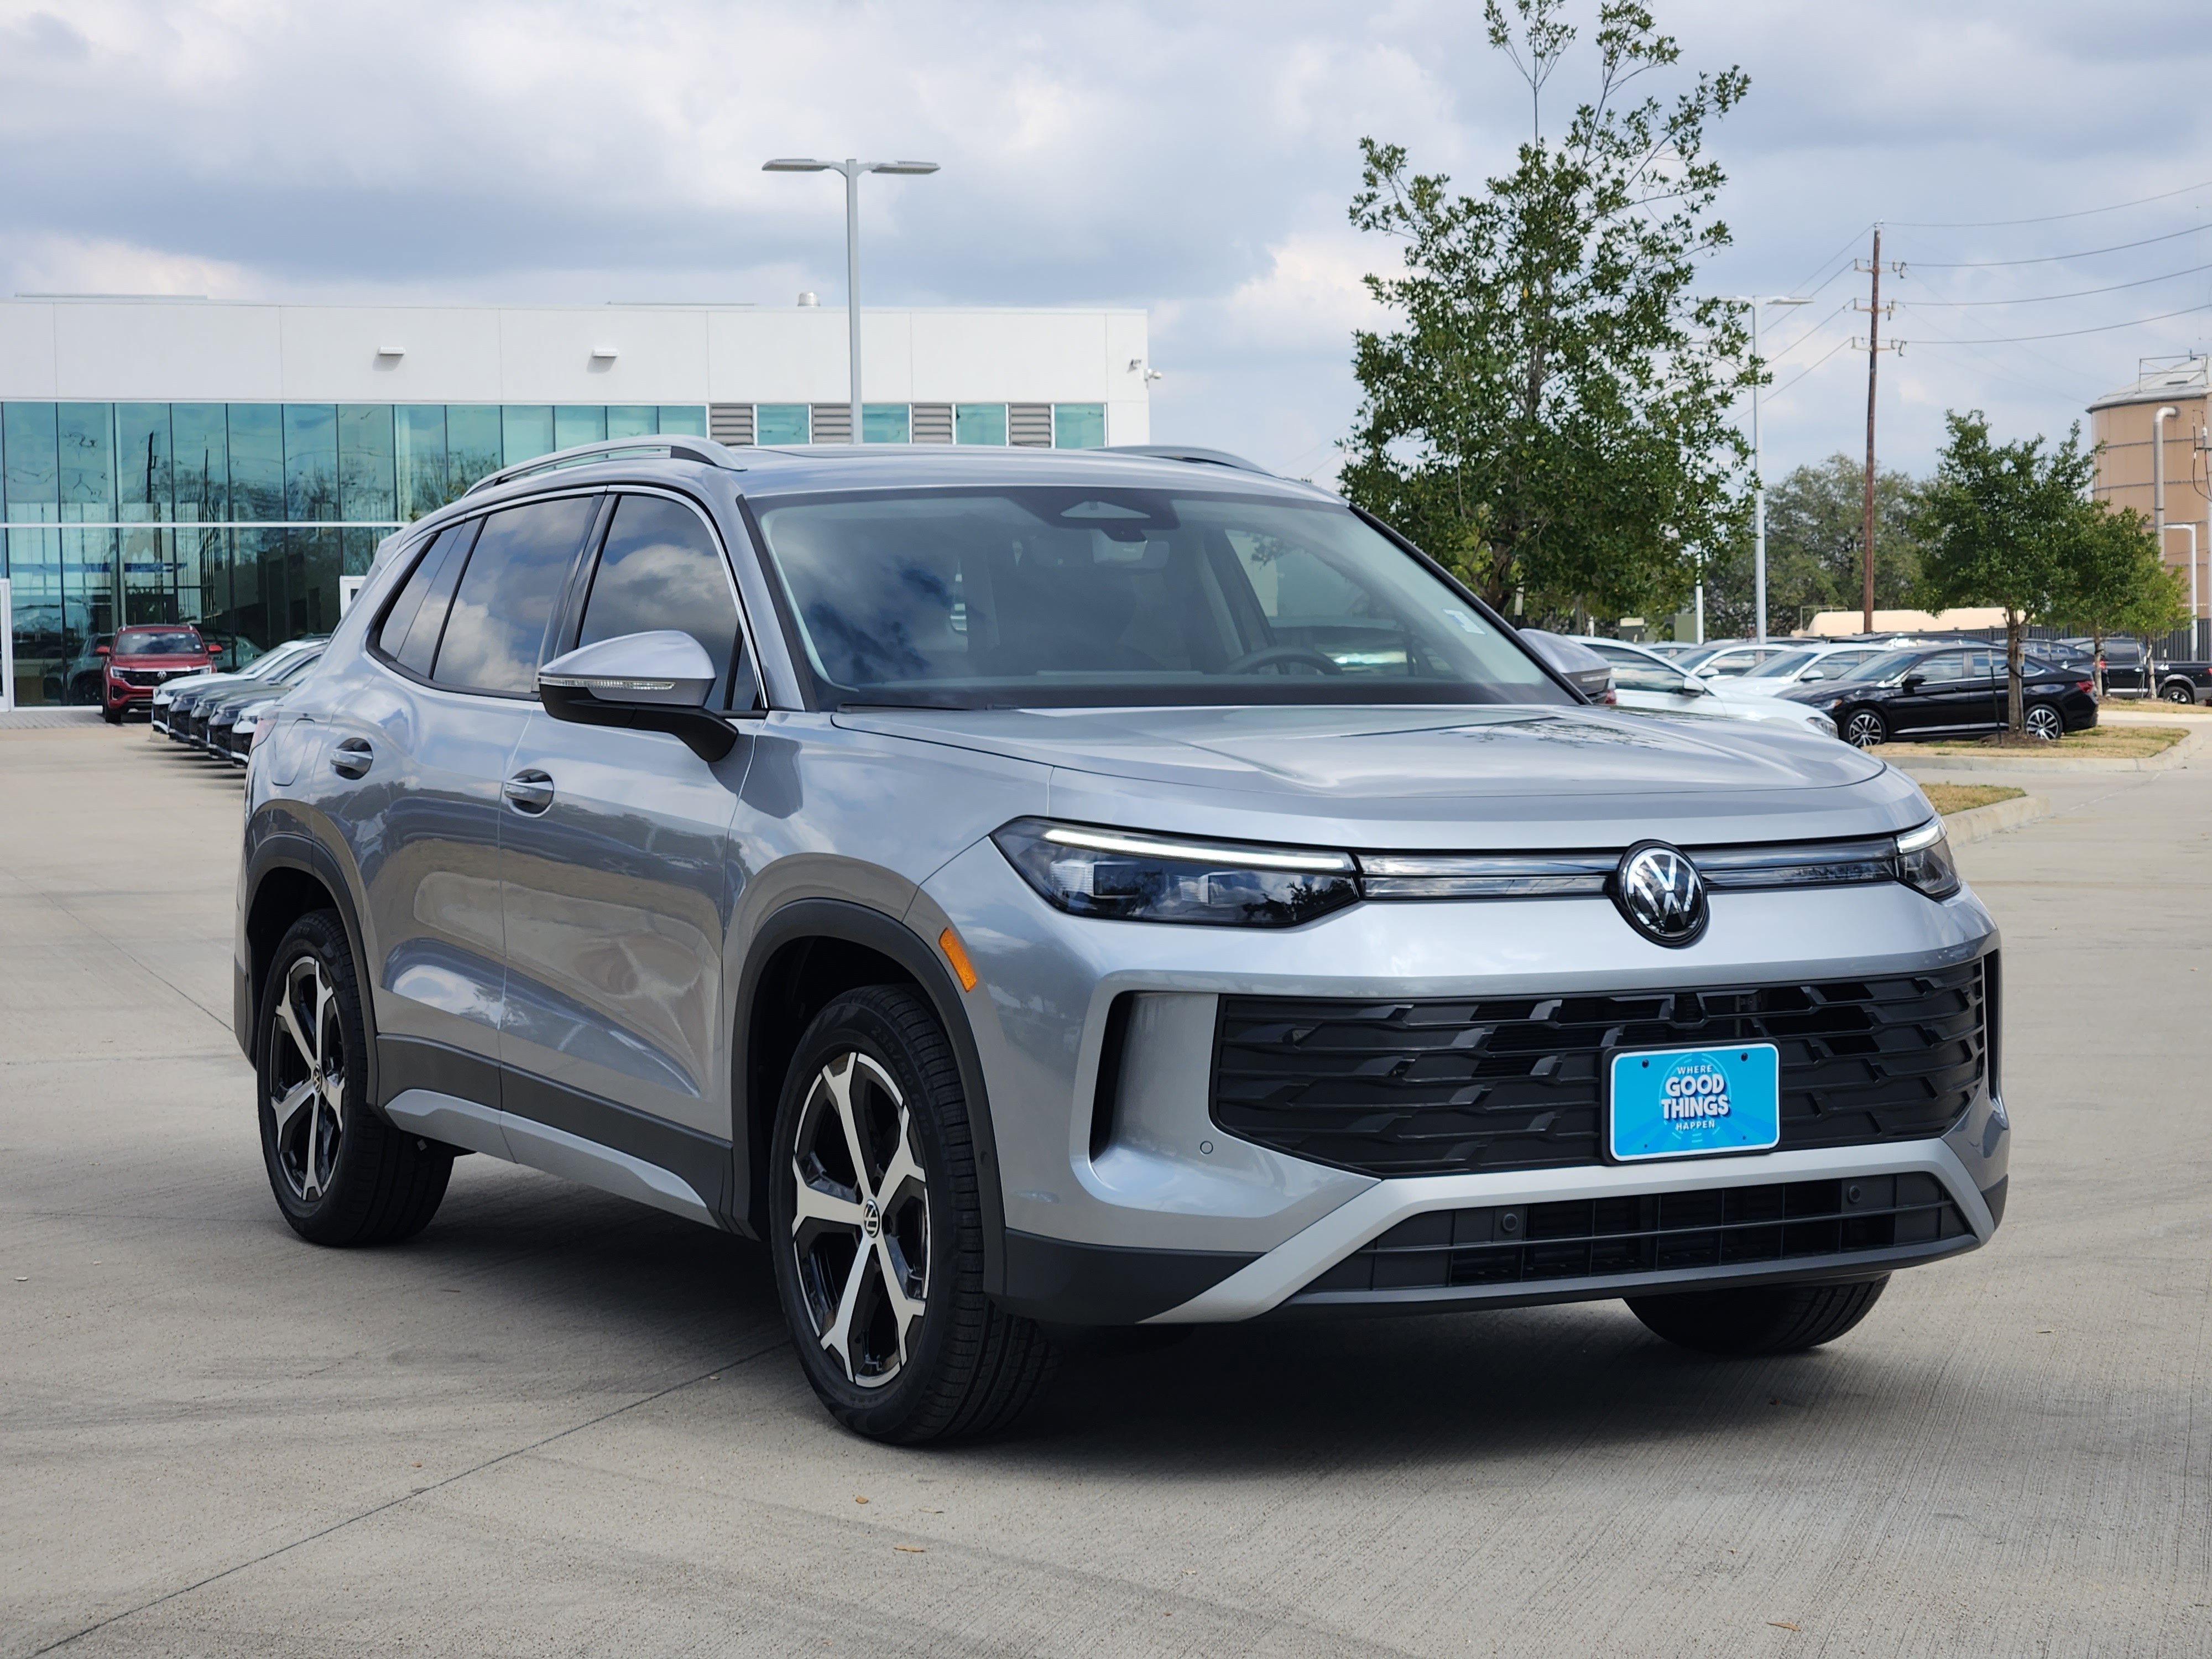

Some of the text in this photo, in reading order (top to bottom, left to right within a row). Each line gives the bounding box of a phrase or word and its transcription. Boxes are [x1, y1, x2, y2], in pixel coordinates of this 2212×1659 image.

[1627, 848, 1703, 937] VW
[870, 1025, 914, 1087] 235/50
[1677, 1065, 1713, 1074] WHERE
[1665, 1073, 1725, 1097] GOOD
[1661, 1094, 1729, 1119] THINGS
[1675, 1120, 1715, 1131] HAPPEN
